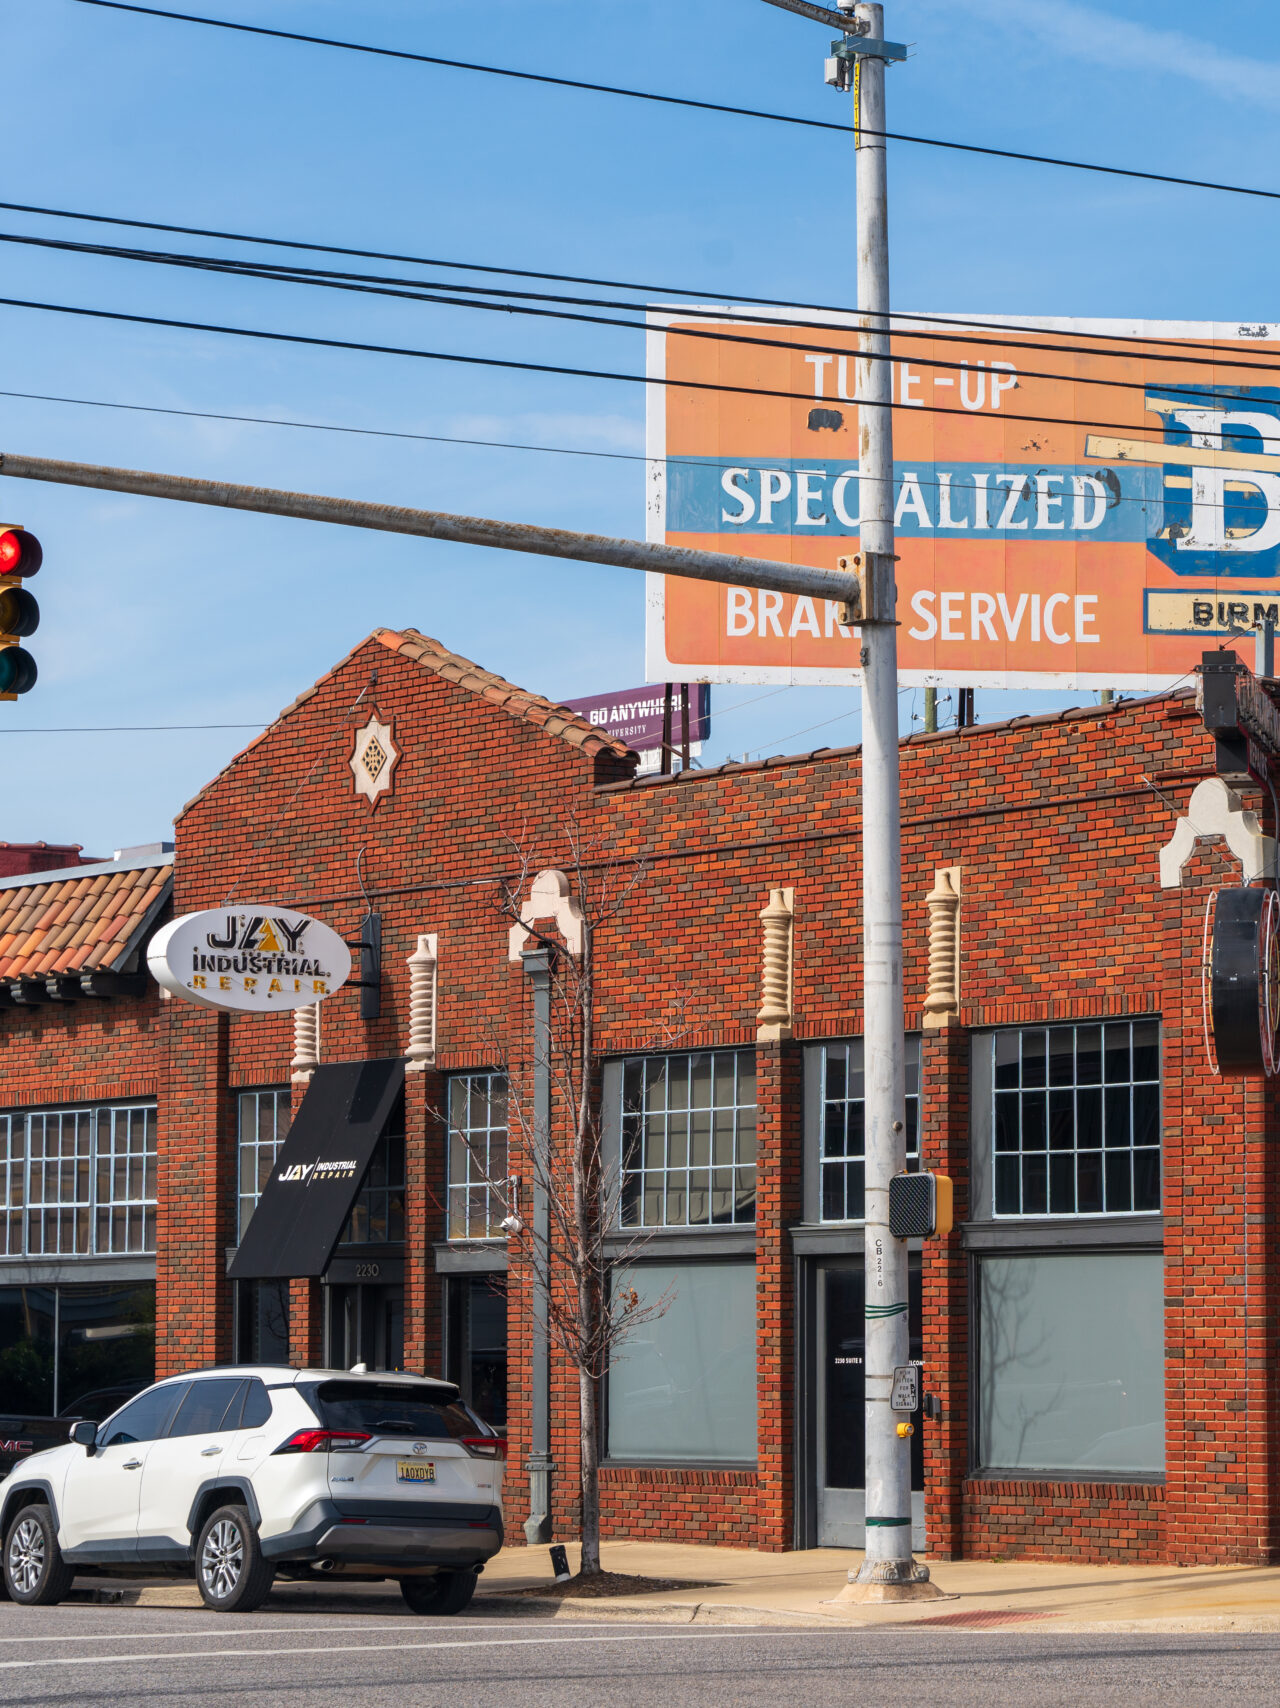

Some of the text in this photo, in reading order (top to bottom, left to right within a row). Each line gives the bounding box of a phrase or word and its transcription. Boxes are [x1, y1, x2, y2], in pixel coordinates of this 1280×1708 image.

[804, 354, 1018, 411] TUE-UP
[721, 467, 1108, 530] SPECALIZED
[726, 586, 1101, 643] BRAK SERVICE
[590, 707, 608, 726] GO
[206, 915, 314, 953] JAY
[193, 975, 328, 995] REPAIR
[278, 1164, 313, 1181] JAY
[316, 1160, 356, 1170] INDUSTRIAL
[312, 1170, 354, 1180] REPAIR
[356, 1264, 380, 1277] 2230
